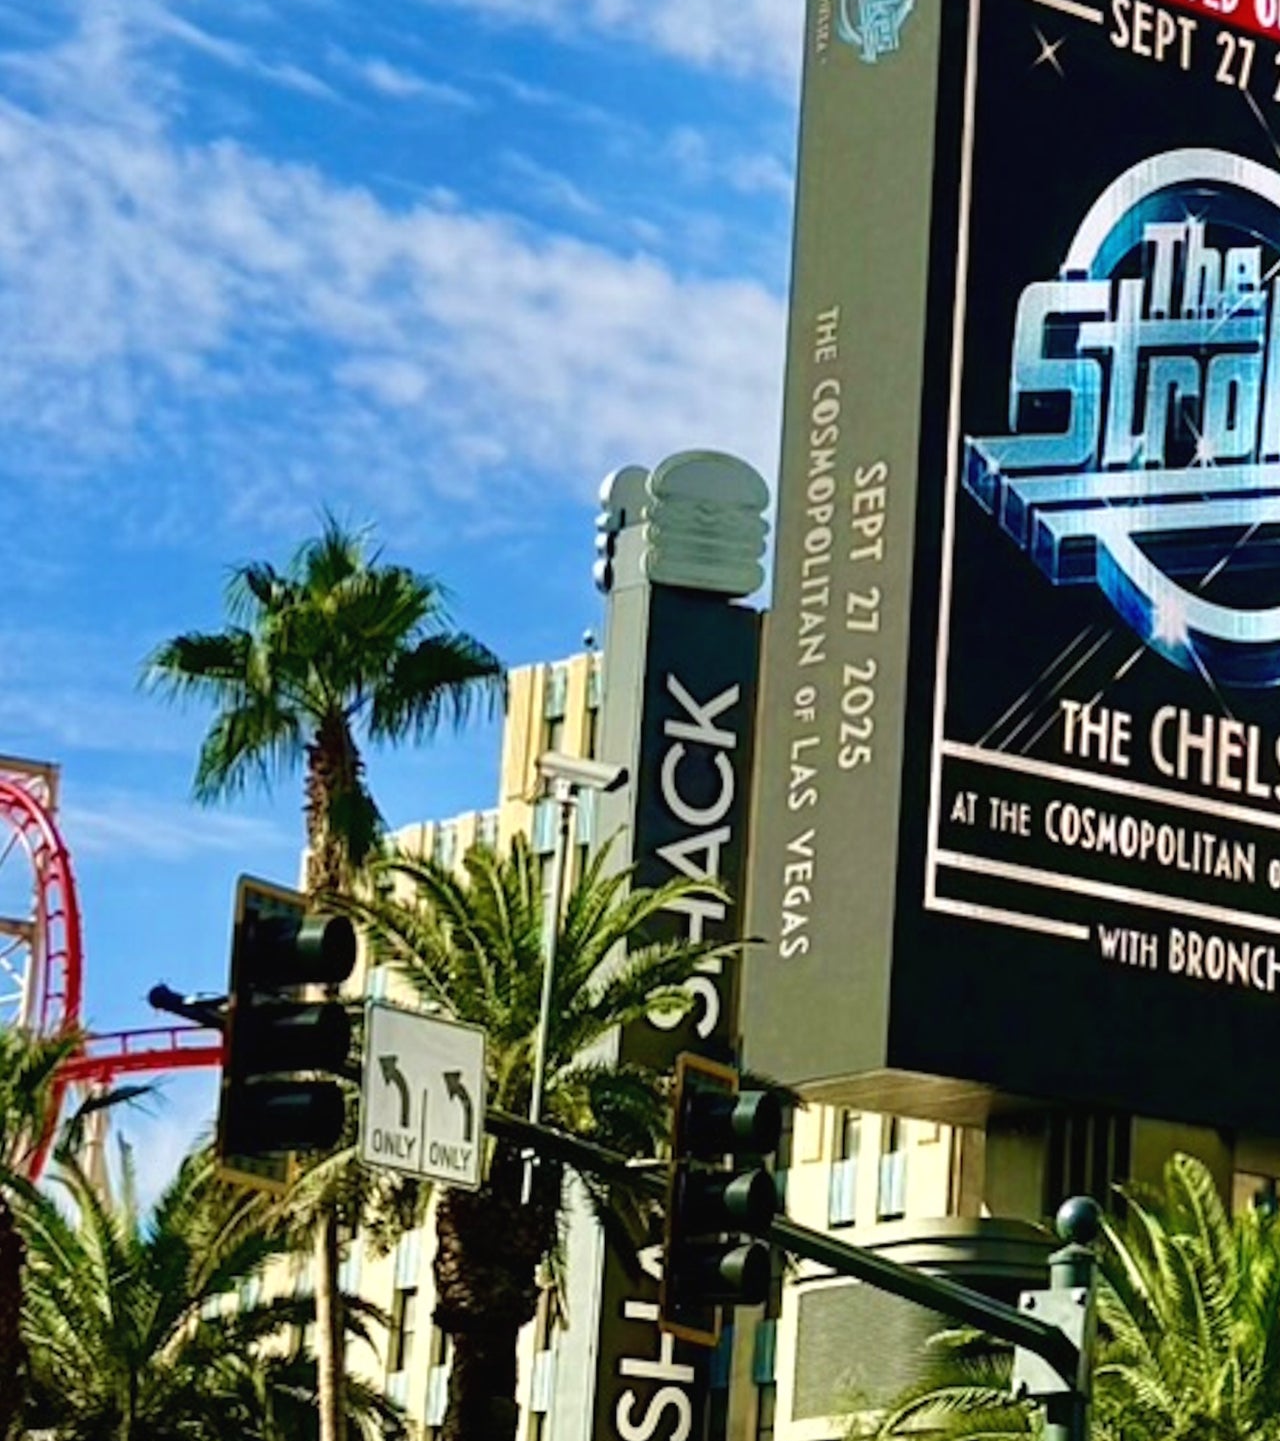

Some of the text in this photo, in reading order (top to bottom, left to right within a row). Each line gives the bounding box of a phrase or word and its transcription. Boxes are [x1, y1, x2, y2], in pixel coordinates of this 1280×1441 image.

[1215, 31, 1255, 90] 27
[1143, 217, 1263, 319] The
[779, 305, 841, 958] THE COSMOPOLITAN OF LAS VEGAS
[838, 461, 888, 769] SEPT 27 2025
[1059, 699, 1132, 766] THE
[645, 673, 740, 1039] SHACK
[951, 791, 978, 825] AT
[989, 797, 1031, 836] THE
[1045, 800, 1256, 883] COSMOPOLITAN
[1099, 924, 1157, 968] WITH
[372, 1128, 416, 1159] ONLY
[430, 1141, 471, 1171] ONLY
